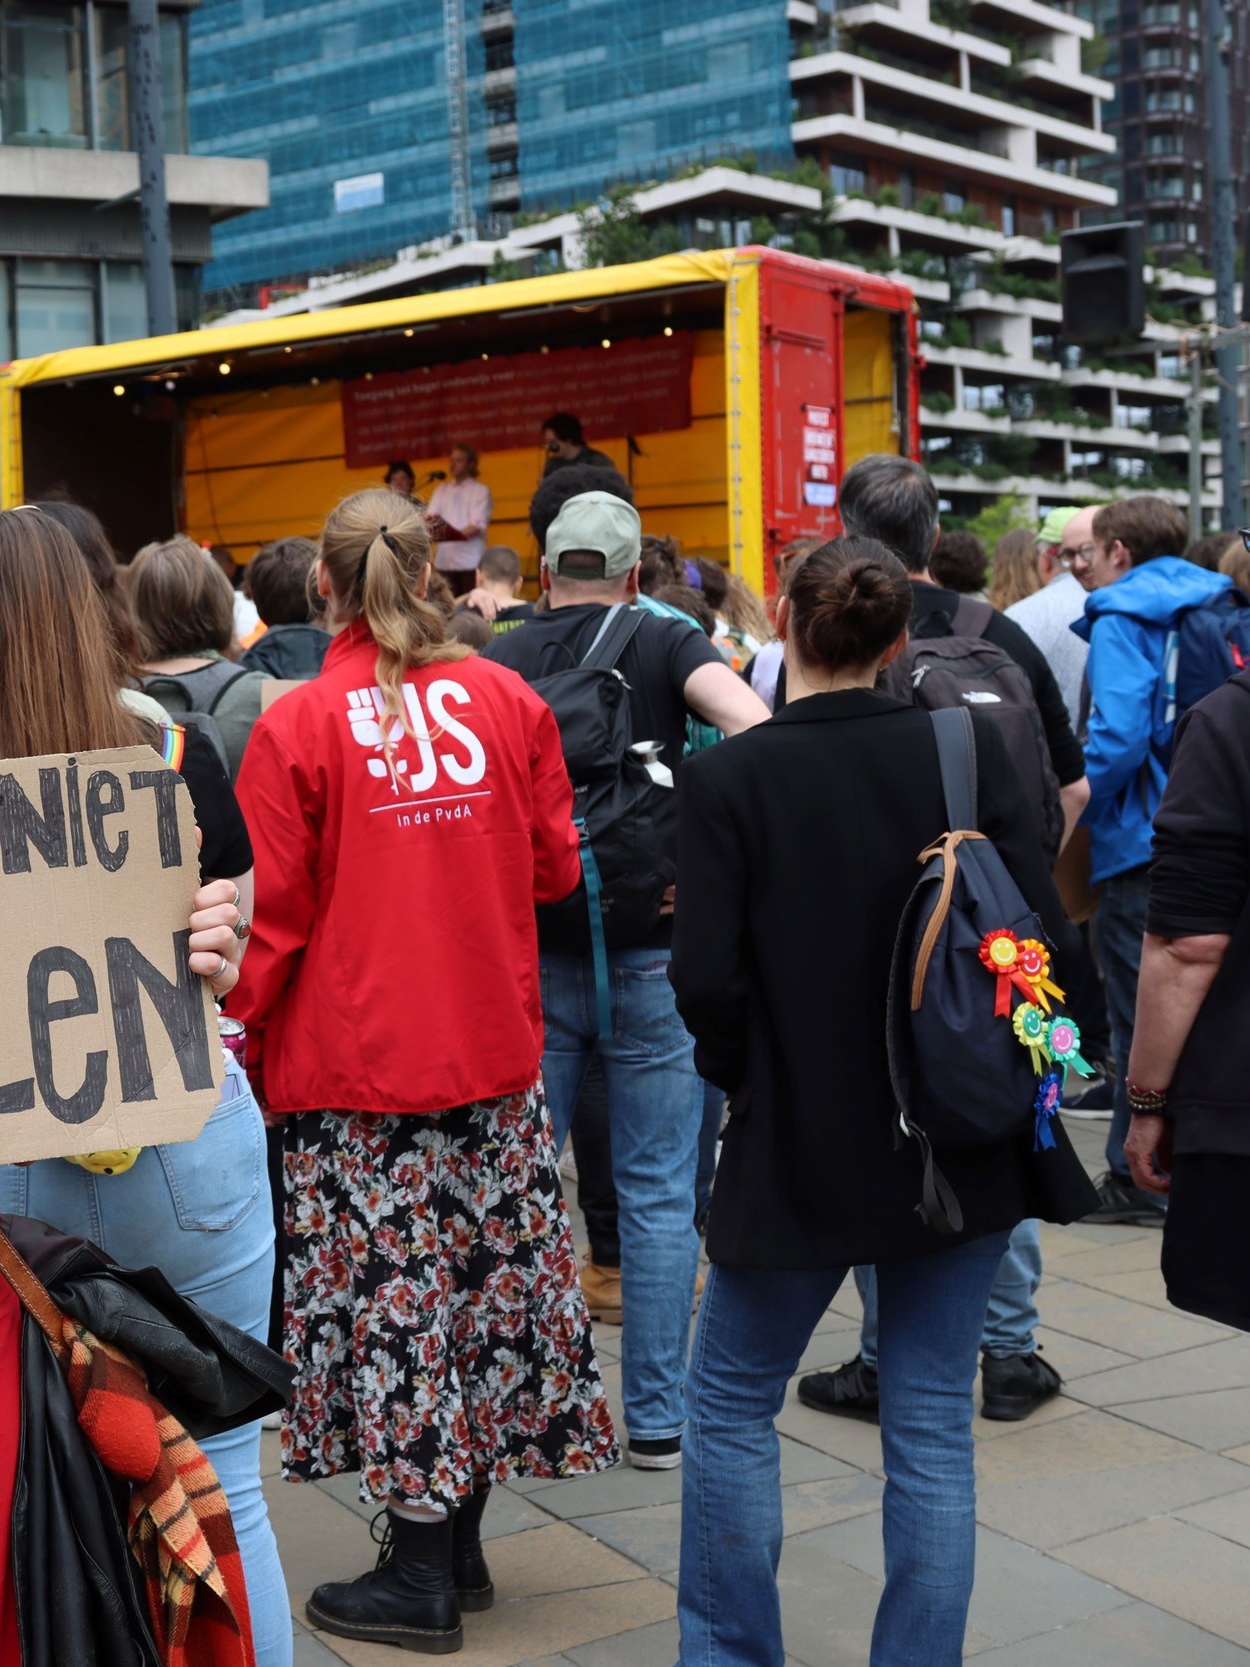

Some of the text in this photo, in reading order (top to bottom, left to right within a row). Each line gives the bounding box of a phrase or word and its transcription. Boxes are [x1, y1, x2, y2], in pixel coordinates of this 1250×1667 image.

[402, 679, 487, 793] JS
[414, 810, 431, 825] de
[435, 803, 473, 823] PvdA
